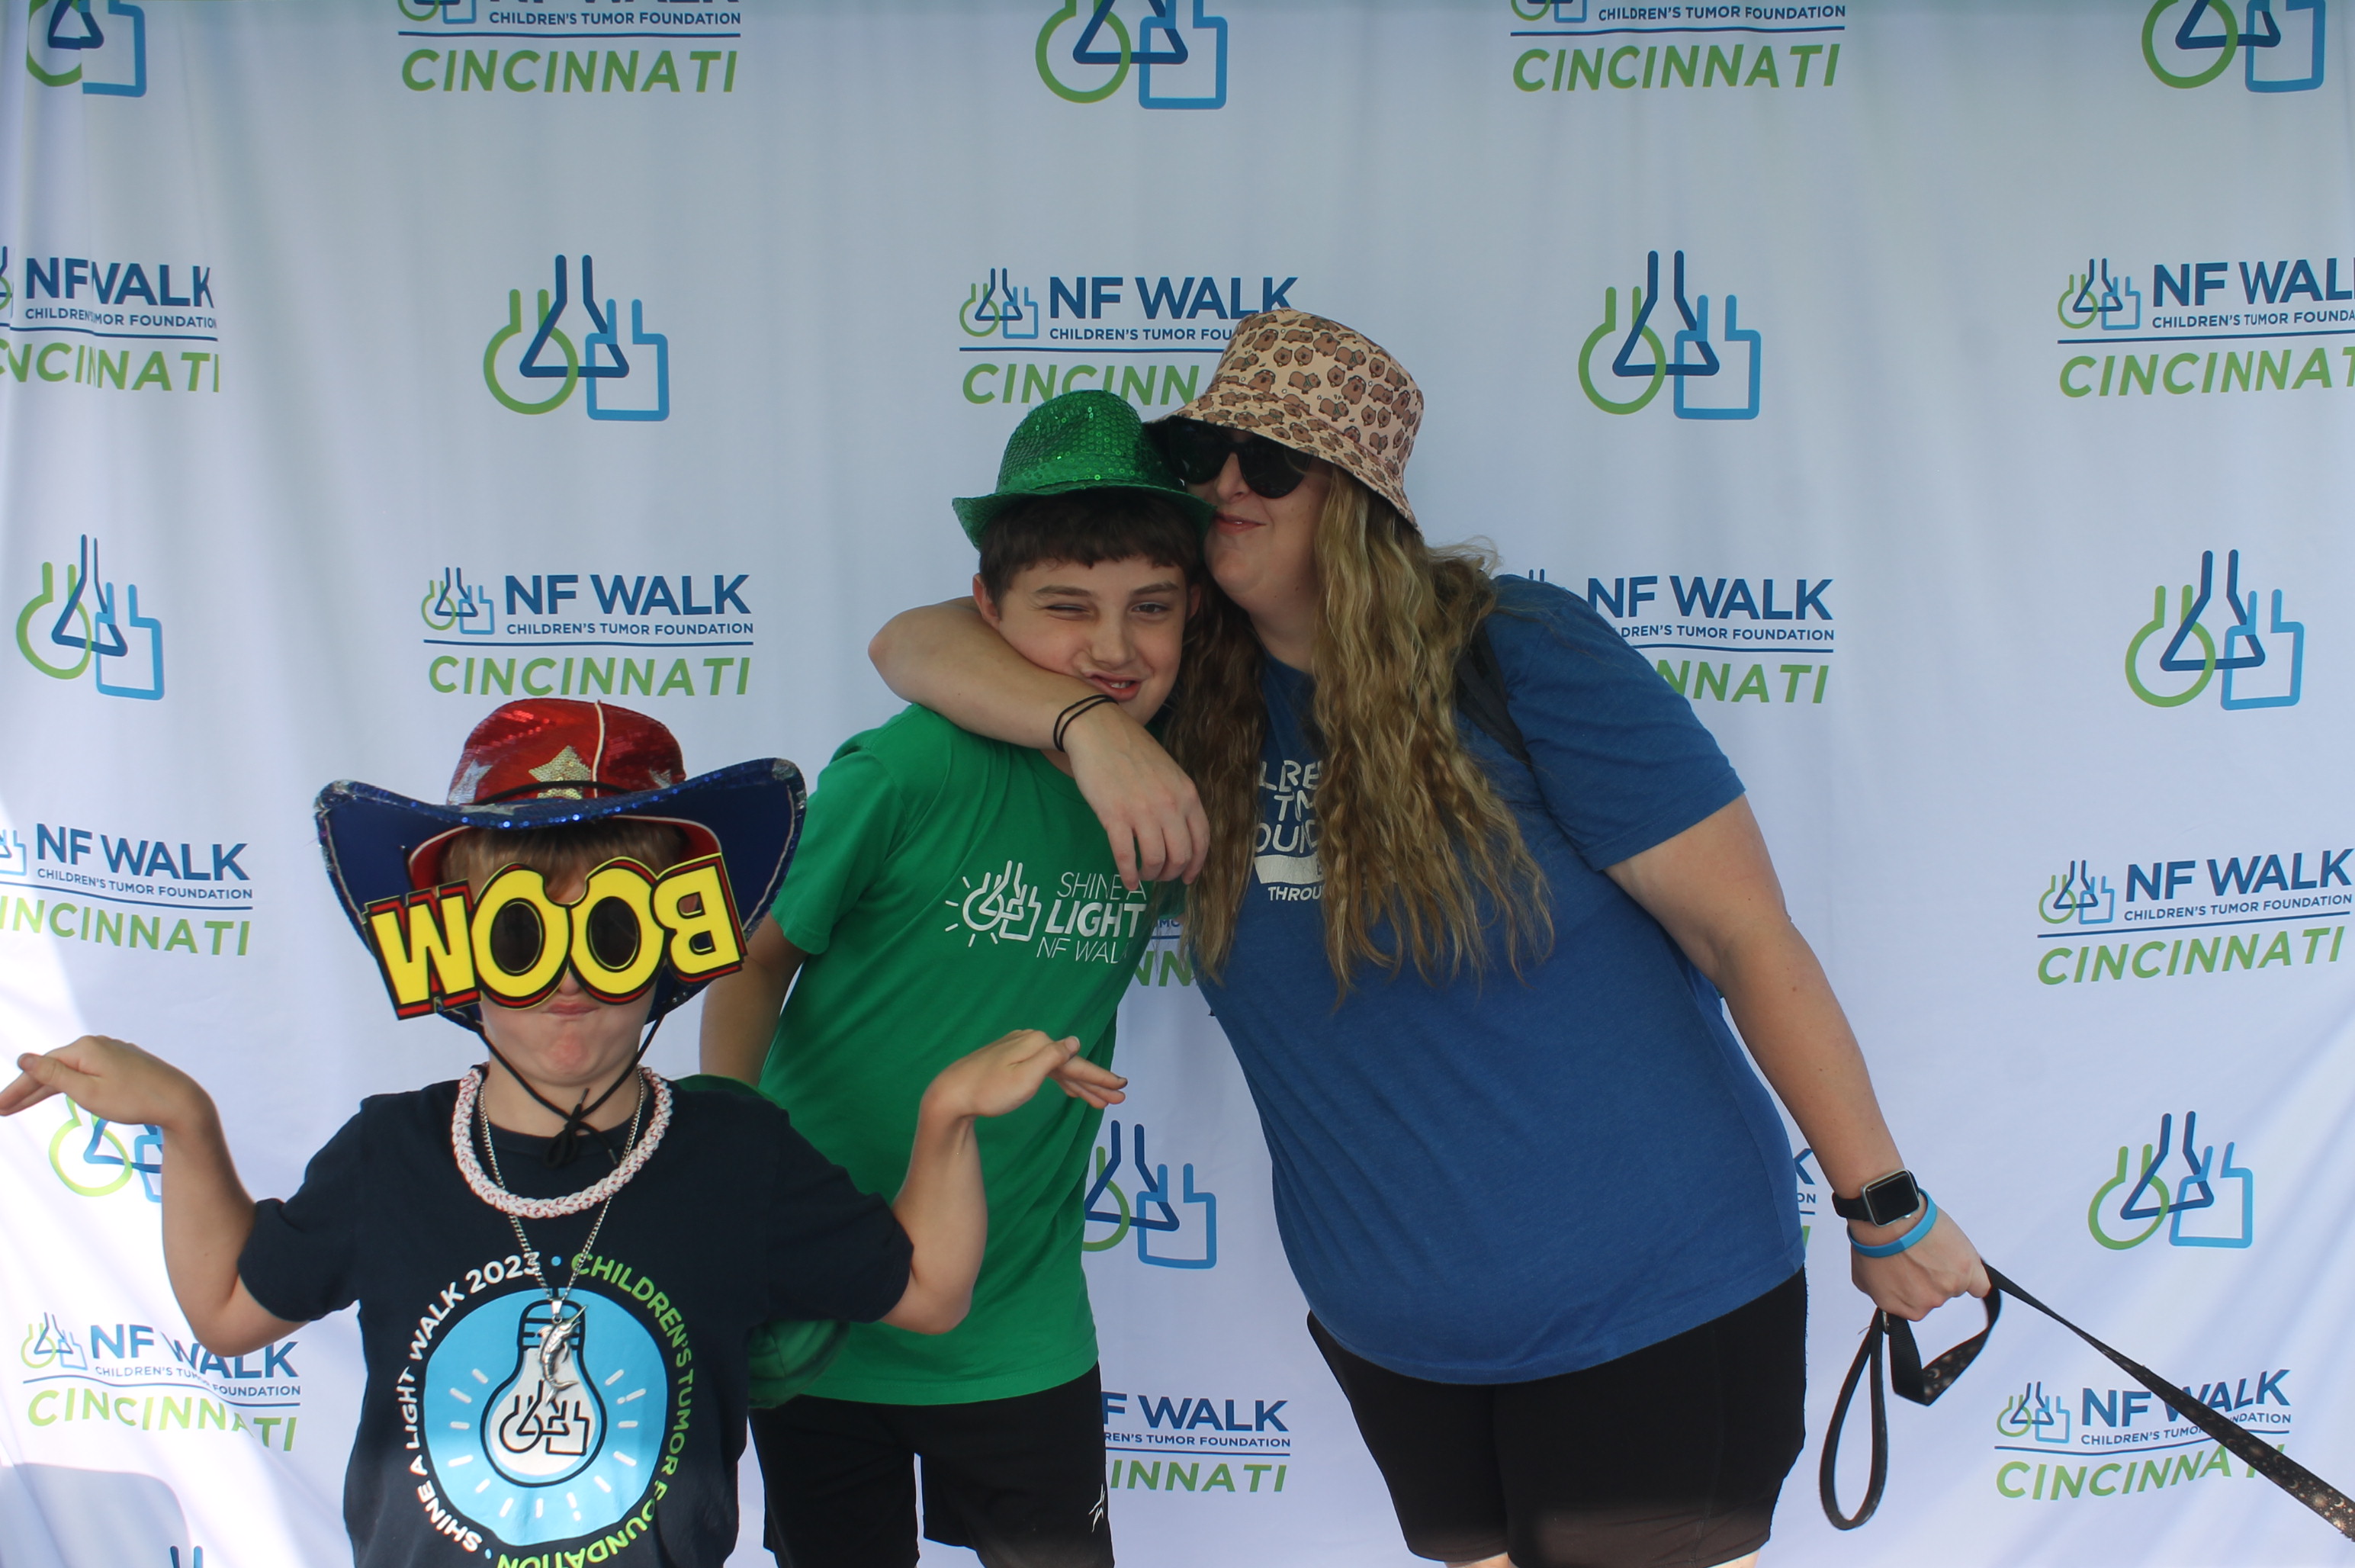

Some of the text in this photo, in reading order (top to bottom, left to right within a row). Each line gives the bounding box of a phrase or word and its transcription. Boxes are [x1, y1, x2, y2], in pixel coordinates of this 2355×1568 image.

[489, 11, 741, 25] CHILDREN'S TUMOR FOUNDATION
[1598, 5, 1846, 21] CHILDREN'S TUMOR FOUNDATION
[402, 49, 737, 92] CINCINNATI
[1512, 43, 1841, 92] CINCINNATI
[26, 257, 88, 299] NF
[1049, 276, 1298, 320] NF WALK
[2153, 257, 2355, 307] NF WAL
[1049, 328, 1138, 341] CHILDREN'S
[1142, 329, 1196, 341] TUMOR
[2152, 314, 2241, 329] CHILDREN'S
[2244, 313, 2288, 326] TUMOR
[962, 363, 1200, 406] CINCINN
[506, 574, 751, 615] NF WALK
[1588, 575, 1834, 620] NF WALK
[506, 622, 753, 635] CHILDREN'S TUMOR FOUNDATION
[1677, 625, 1728, 639] TUMOR
[1733, 628, 1834, 641] FOUNDATION
[429, 655, 750, 696] CINCINNATI
[37, 823, 250, 881] NF WALK
[37, 868, 253, 899] CHILDREN'S TUMOR FOUNDATION
[1057, 872, 1123, 901] SHINE
[1267, 885, 1323, 901] THROU
[2126, 848, 2354, 902] NF WALK
[1045, 898, 1147, 938] LIGHT
[2124, 893, 2353, 922] CHILDREN'S TUMOR FOUNDATION
[1036, 936, 1071, 959] NF
[2038, 926, 2345, 985] CINCINNATI
[91, 1323, 154, 1359] NF
[95, 1365, 173, 1377] CHILDREN'S
[212, 1383, 301, 1398] FOUNDATION
[571, 1252, 692, 1367] CHILDREN'S
[661, 1367, 695, 1476] TUMOR
[28, 1387, 297, 1452] CINCINNATI
[396, 1251, 541, 1553] SHINE A LIGHT WALK 2023
[1137, 1394, 1289, 1432] WALK
[2081, 1387, 2151, 1427] NF
[1146, 1434, 1195, 1445] TUMOR
[1200, 1437, 1290, 1448] FOUNDATION
[2080, 1430, 2161, 1445] CHILDREN'S
